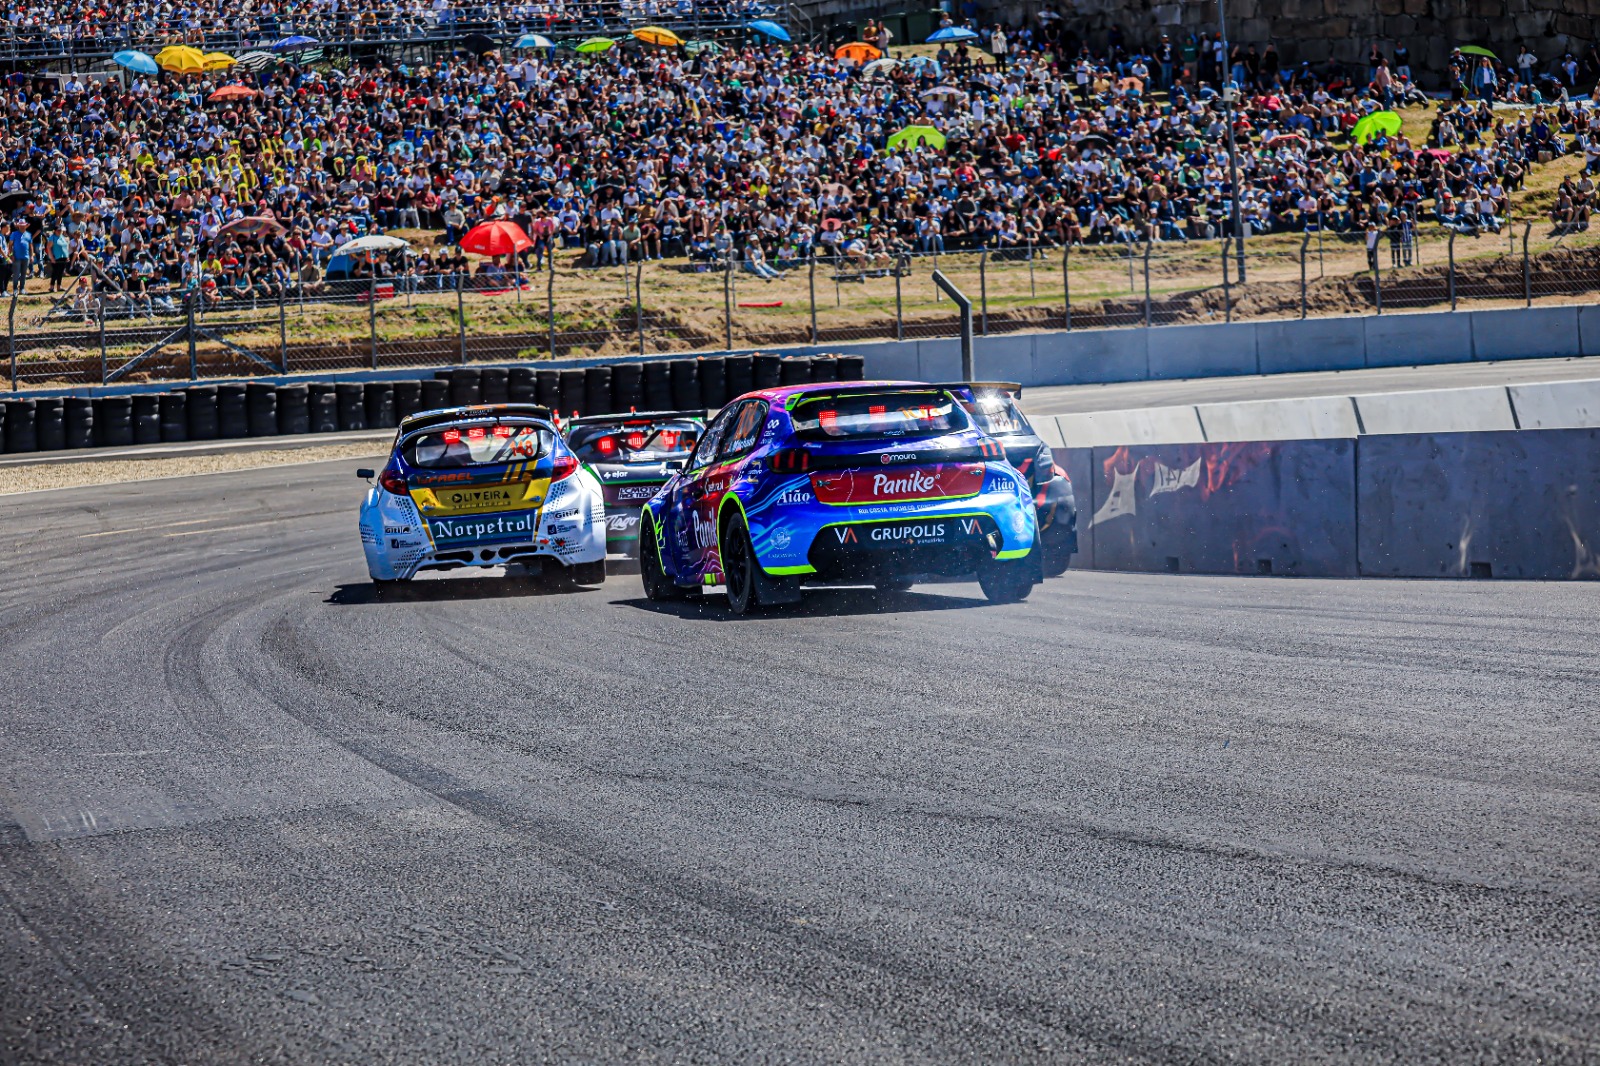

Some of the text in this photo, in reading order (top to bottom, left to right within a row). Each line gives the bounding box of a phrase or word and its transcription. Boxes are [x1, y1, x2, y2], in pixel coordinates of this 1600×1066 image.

[988, 477, 1015, 491] Aião
[777, 489, 811, 504] Aião
[434, 514, 531, 540] Norpetrol
[870, 523, 945, 541] GRUPOLIS
